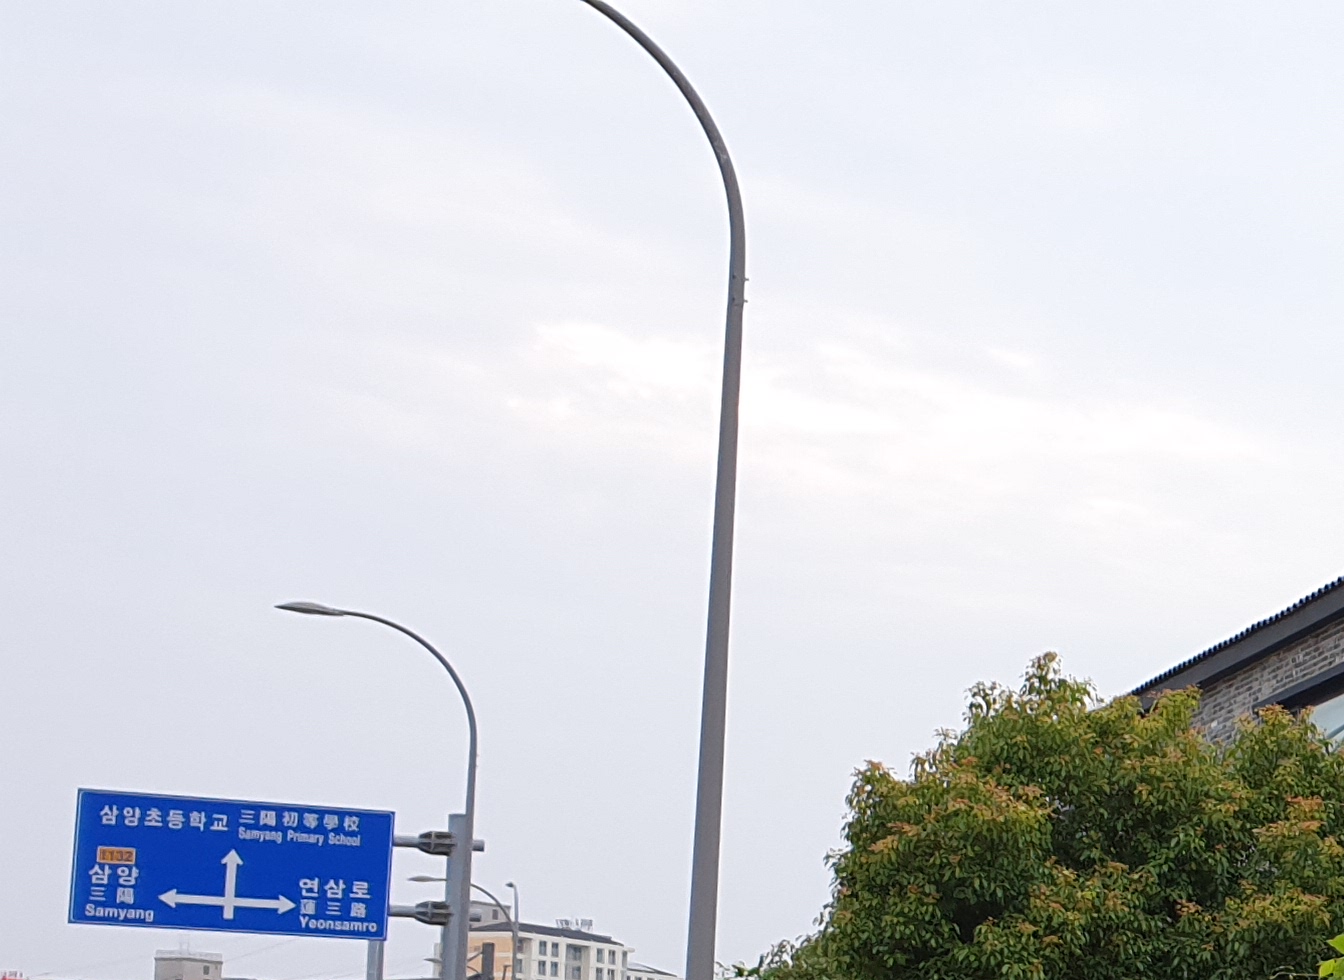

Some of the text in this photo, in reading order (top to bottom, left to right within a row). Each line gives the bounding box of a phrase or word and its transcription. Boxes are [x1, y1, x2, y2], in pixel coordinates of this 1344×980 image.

[100, 805, 229, 832] 삼양초등학교
[238, 826, 361, 846] Samyang Primary School
[88, 864, 140, 885] 삼양
[299, 876, 372, 899] 연삼로
[85, 903, 154, 922] Samyang
[299, 915, 378, 932] Yeonsamro
